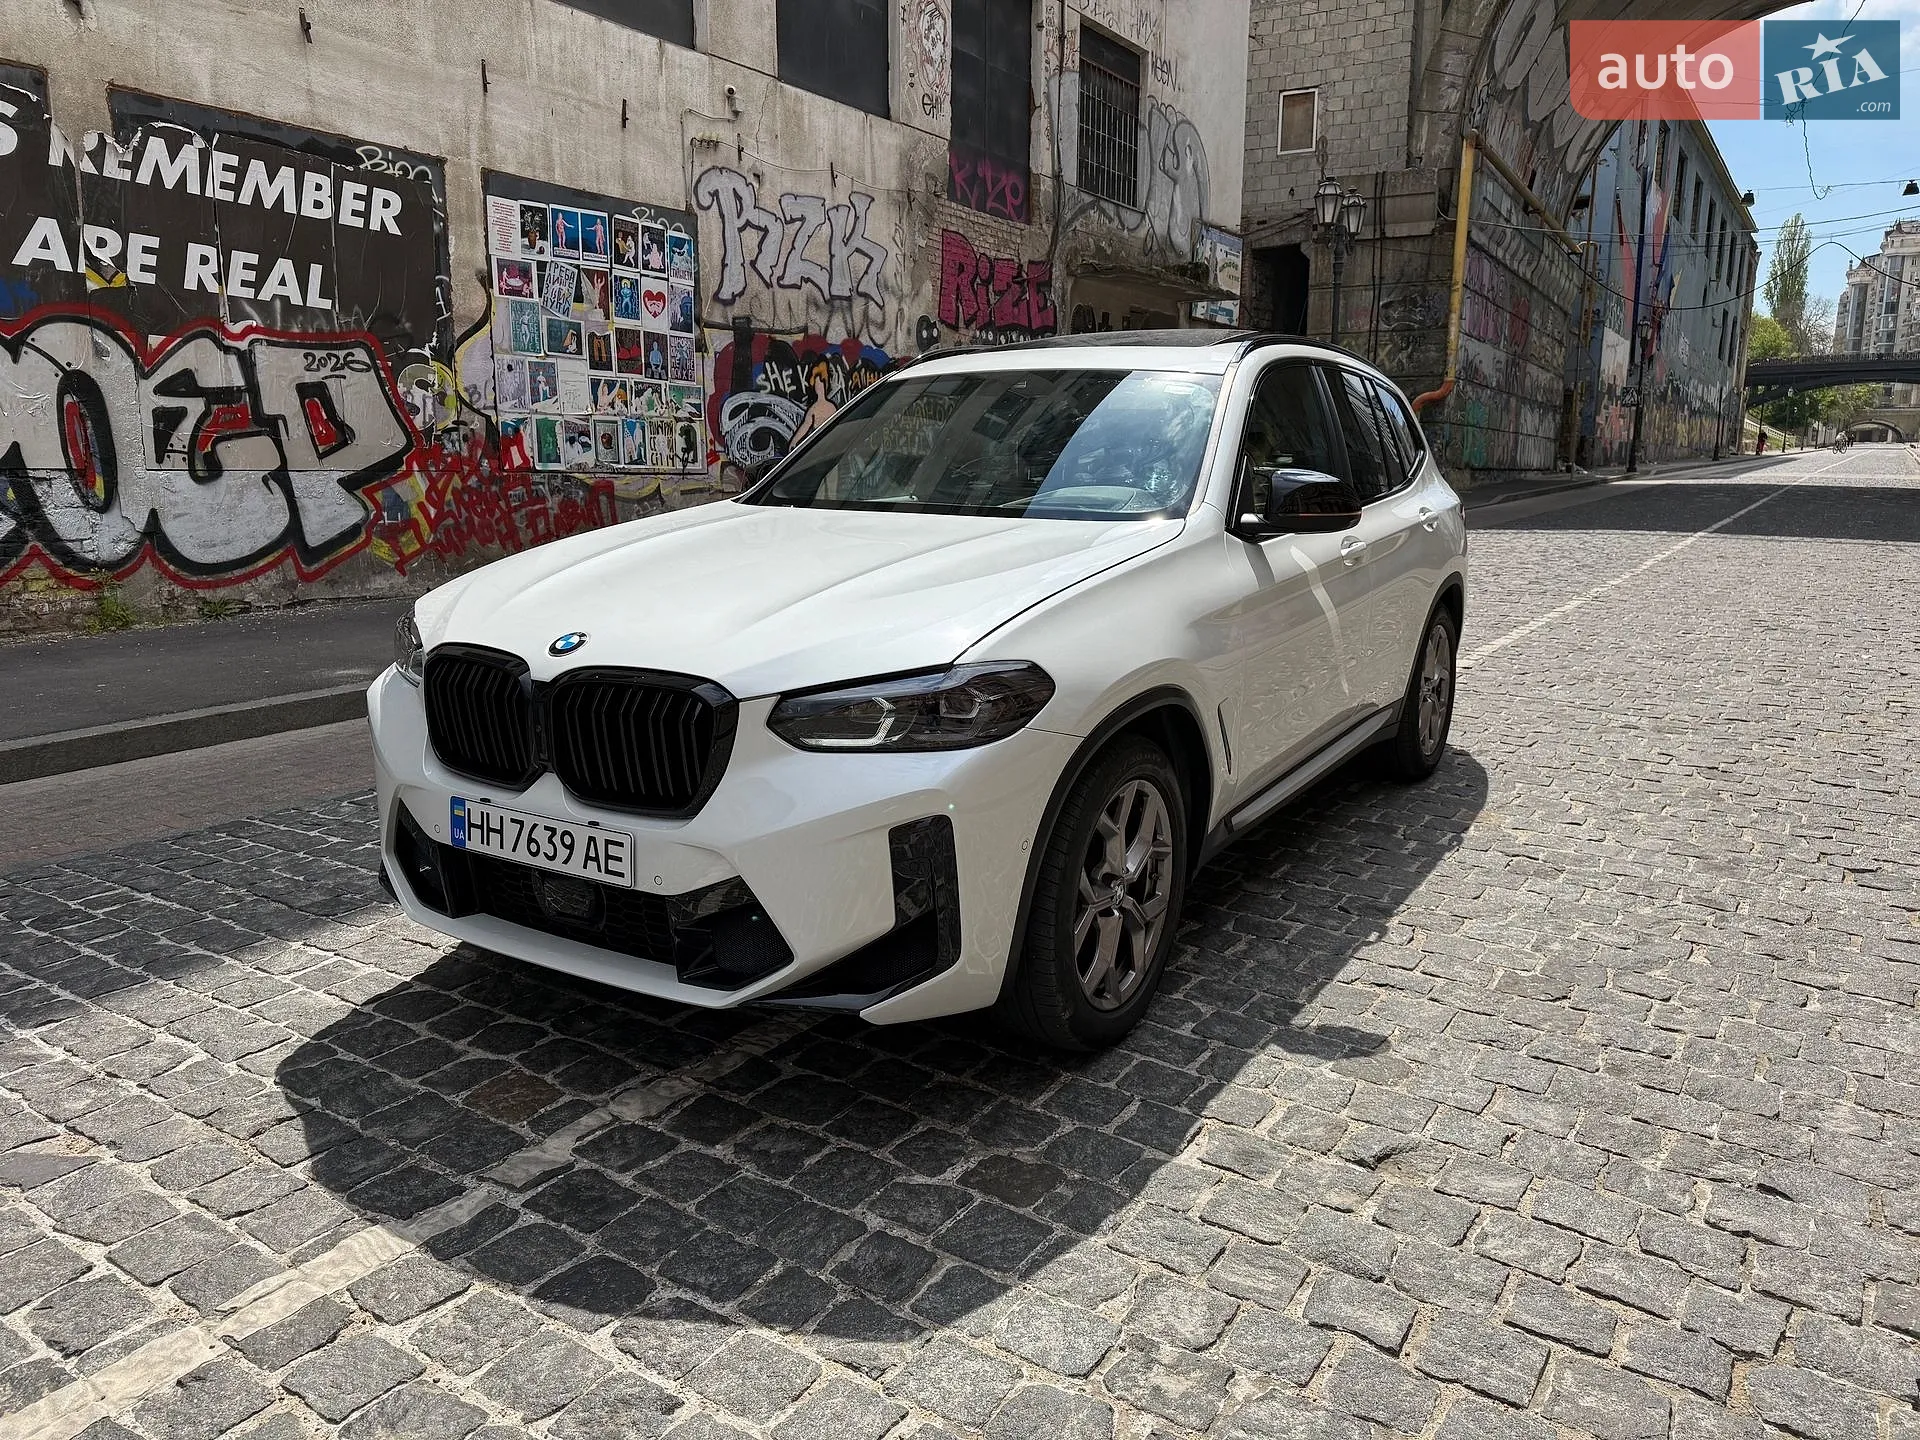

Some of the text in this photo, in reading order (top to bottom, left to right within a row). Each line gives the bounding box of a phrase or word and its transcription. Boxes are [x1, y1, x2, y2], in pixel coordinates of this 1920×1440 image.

[11, 216, 333, 310] ARE REAL
[302, 351, 372, 373] 2026
[453, 807, 626, 879] UA HH 7639 AE
